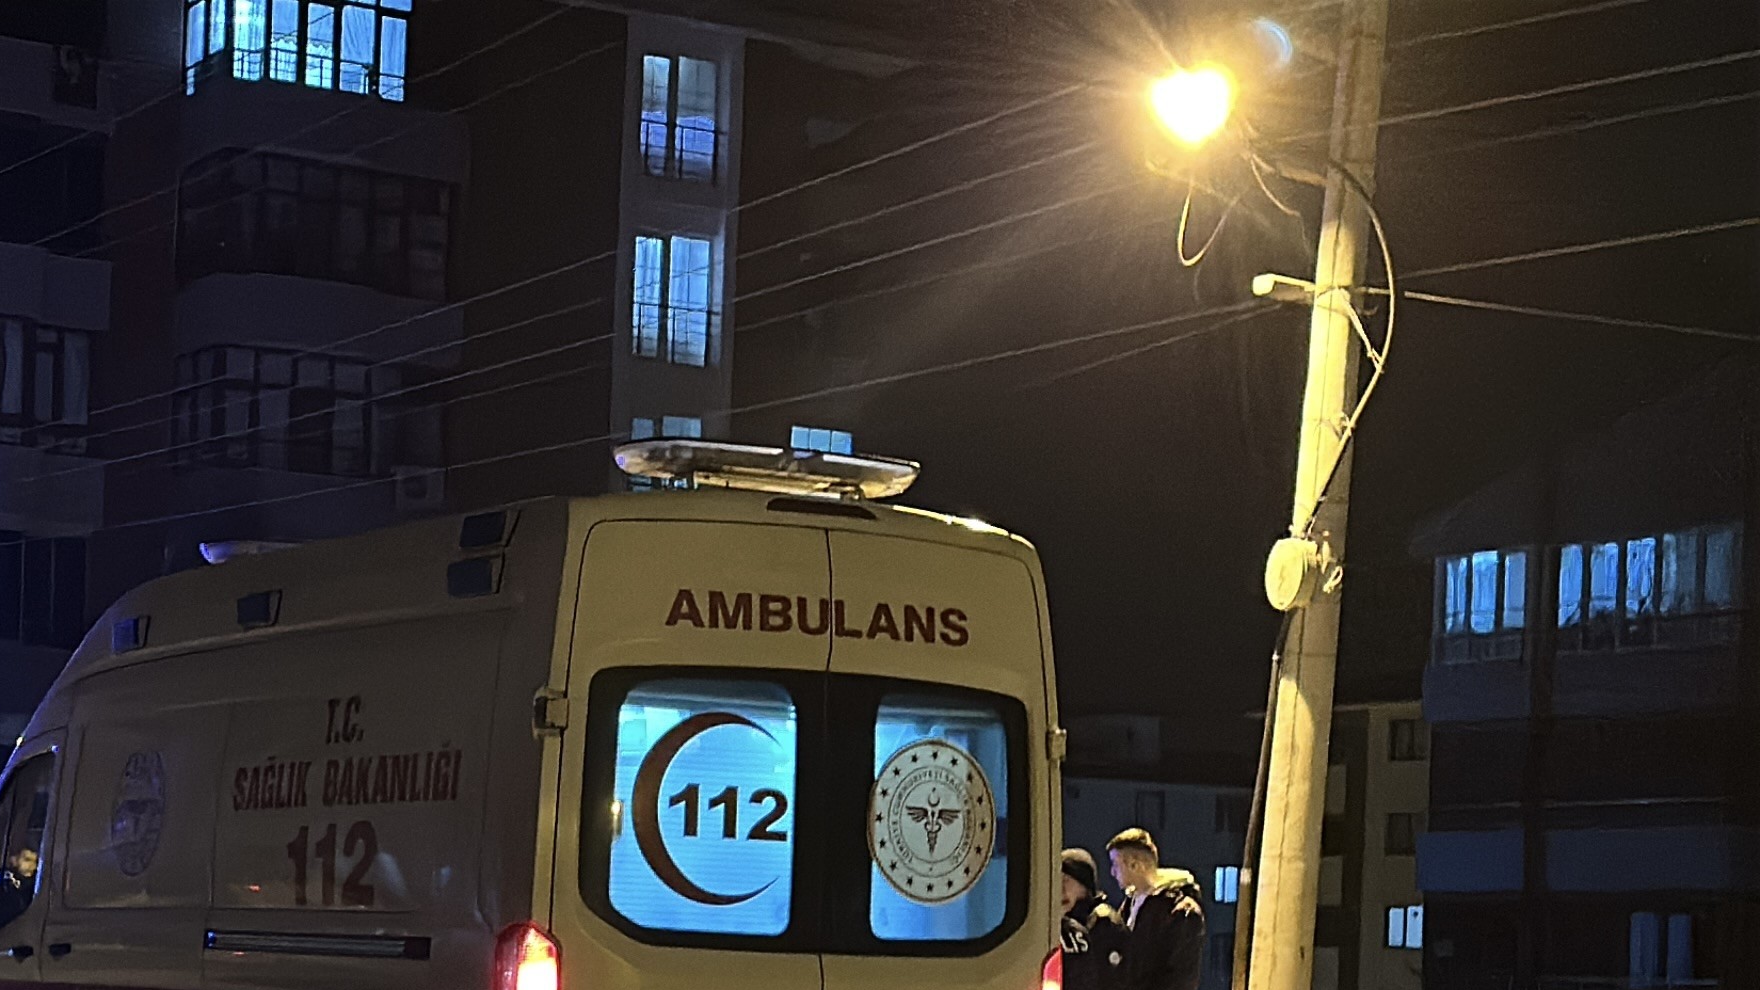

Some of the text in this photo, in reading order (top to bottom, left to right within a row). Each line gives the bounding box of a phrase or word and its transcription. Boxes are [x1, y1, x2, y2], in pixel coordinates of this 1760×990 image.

[665, 589, 970, 646] AMBULANS
[233, 740, 463, 811] SAĞLIK BAKANLIĞI
[669, 783, 788, 841] 112
[287, 820, 378, 906] 112
[1060, 931, 1089, 953] LIS
